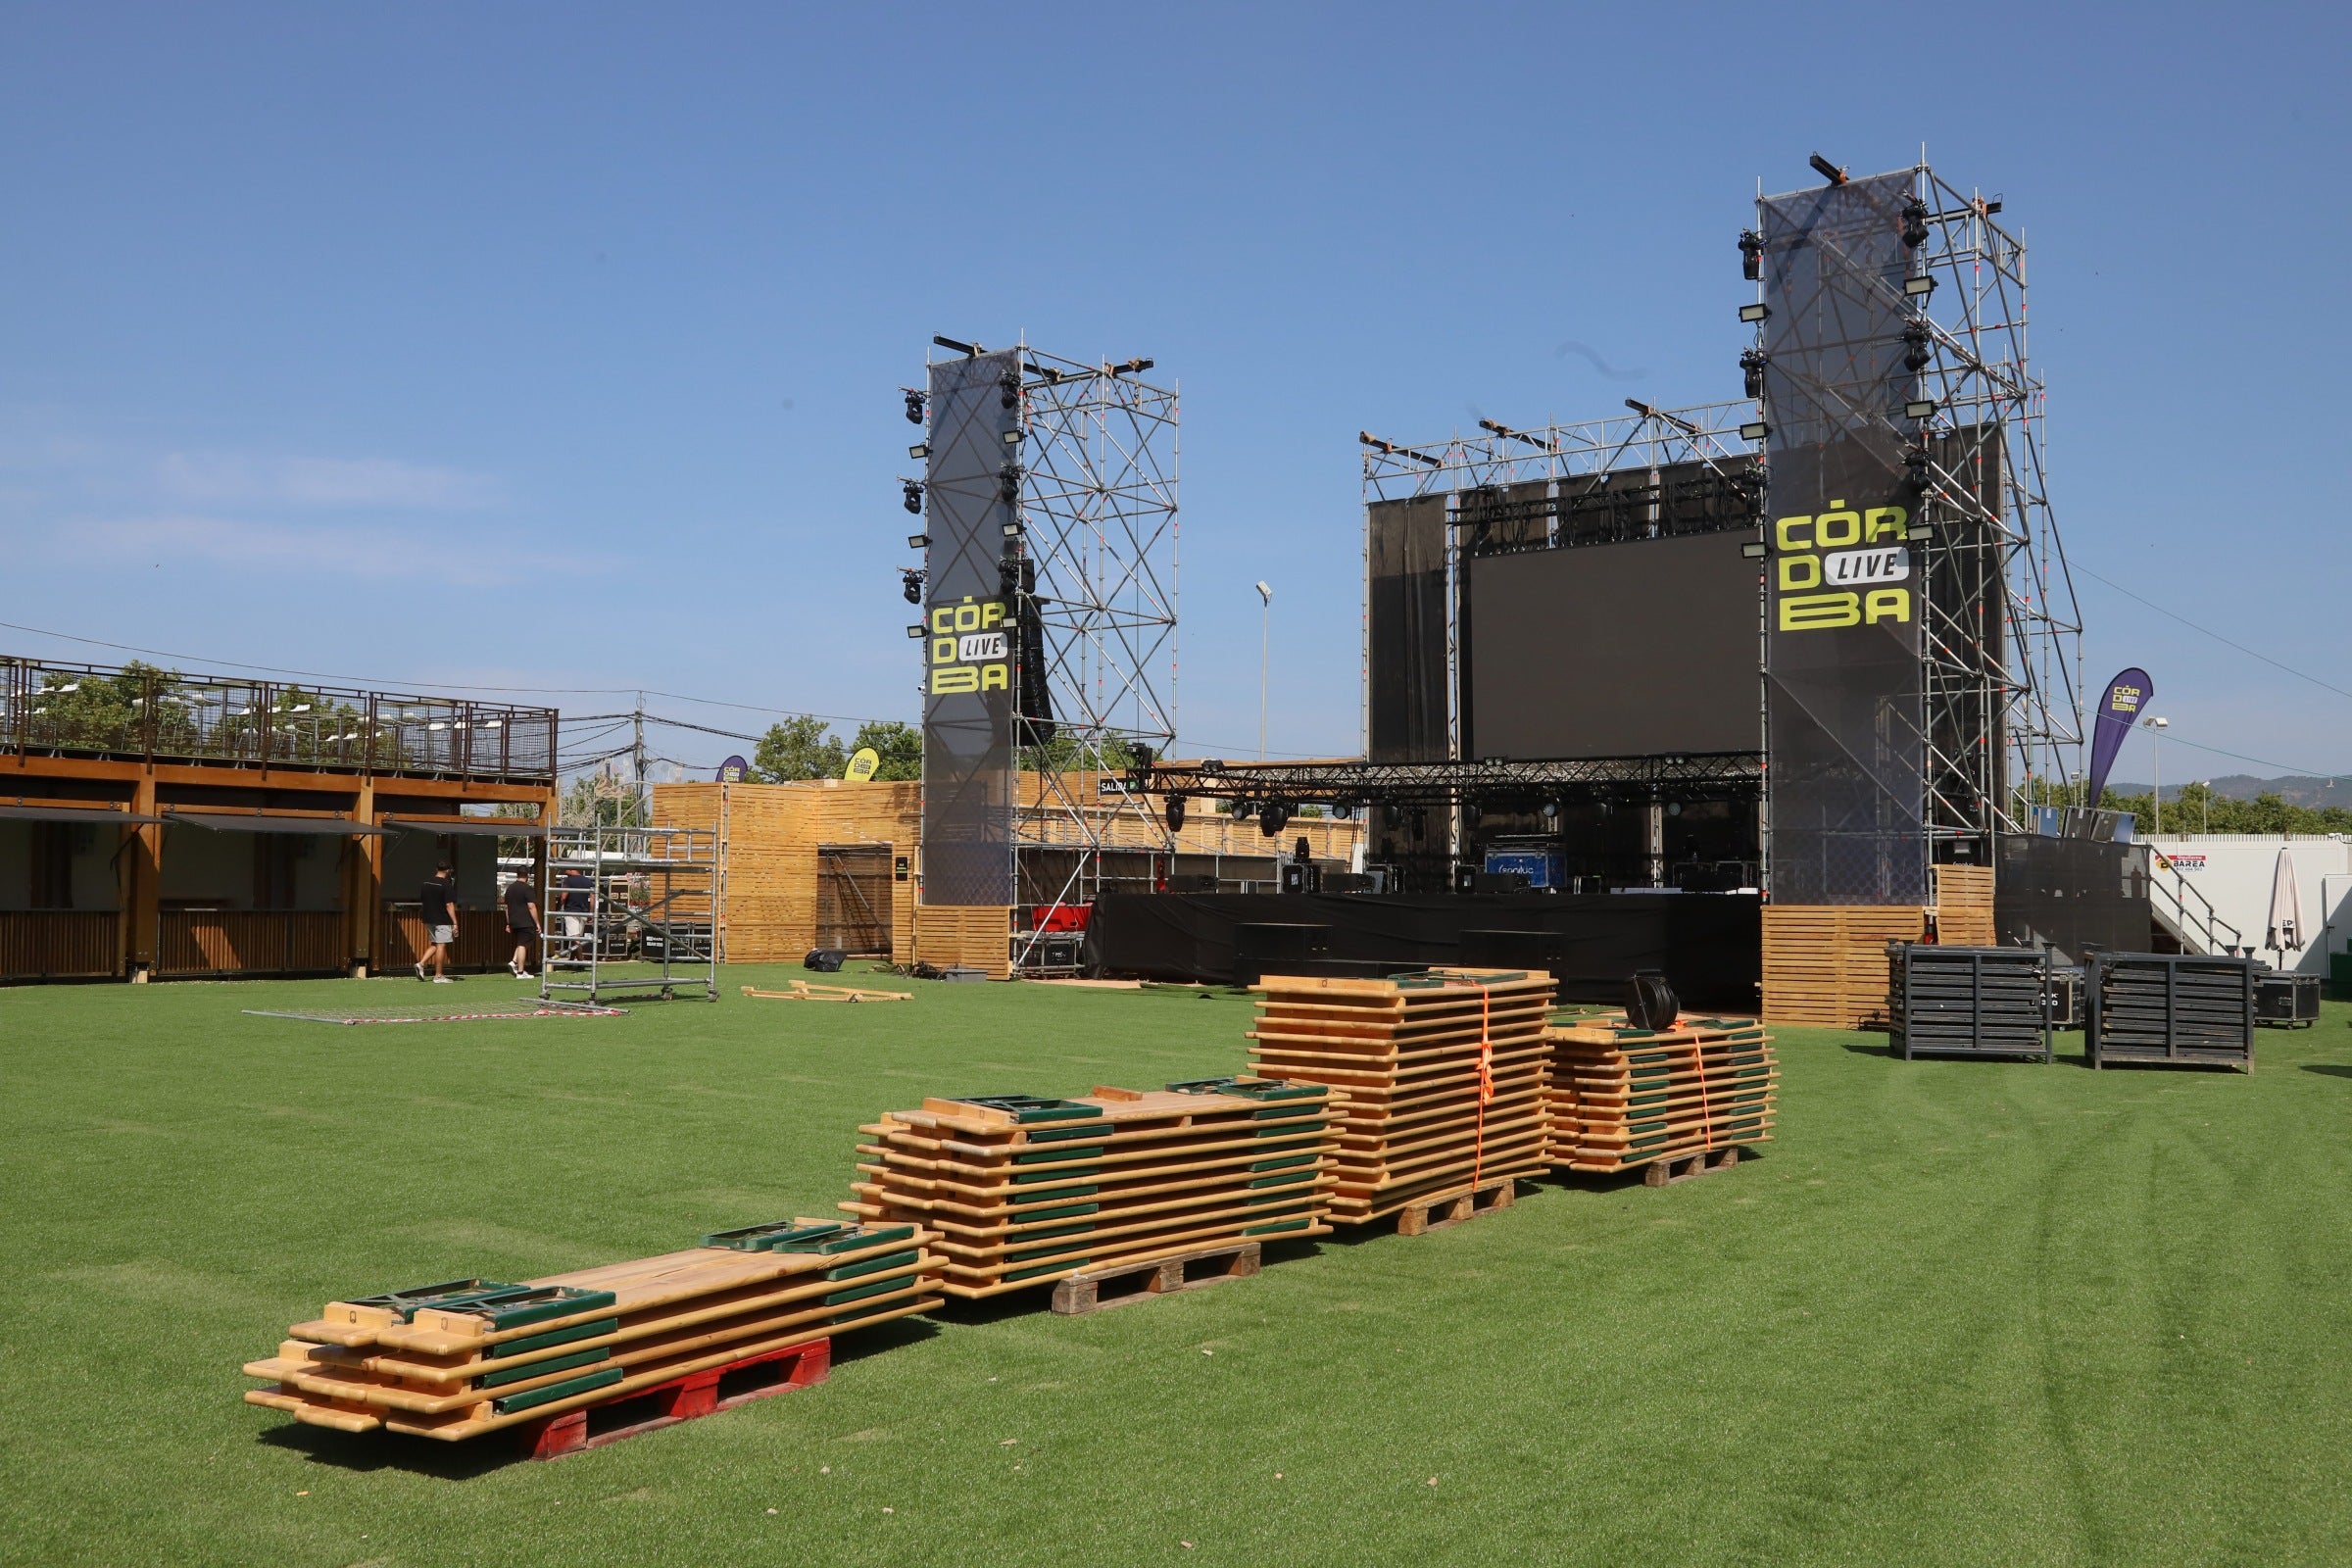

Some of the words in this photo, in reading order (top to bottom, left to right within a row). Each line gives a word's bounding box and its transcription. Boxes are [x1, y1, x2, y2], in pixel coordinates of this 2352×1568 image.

[1776, 499, 1908, 551] CÓR
[1778, 554, 1821, 591] D
[1837, 553, 1897, 579] LIVE
[1779, 588, 1910, 631] BA
[932, 636, 957, 664] D
[965, 637, 1001, 657] LIVE
[931, 663, 1007, 695] BA
